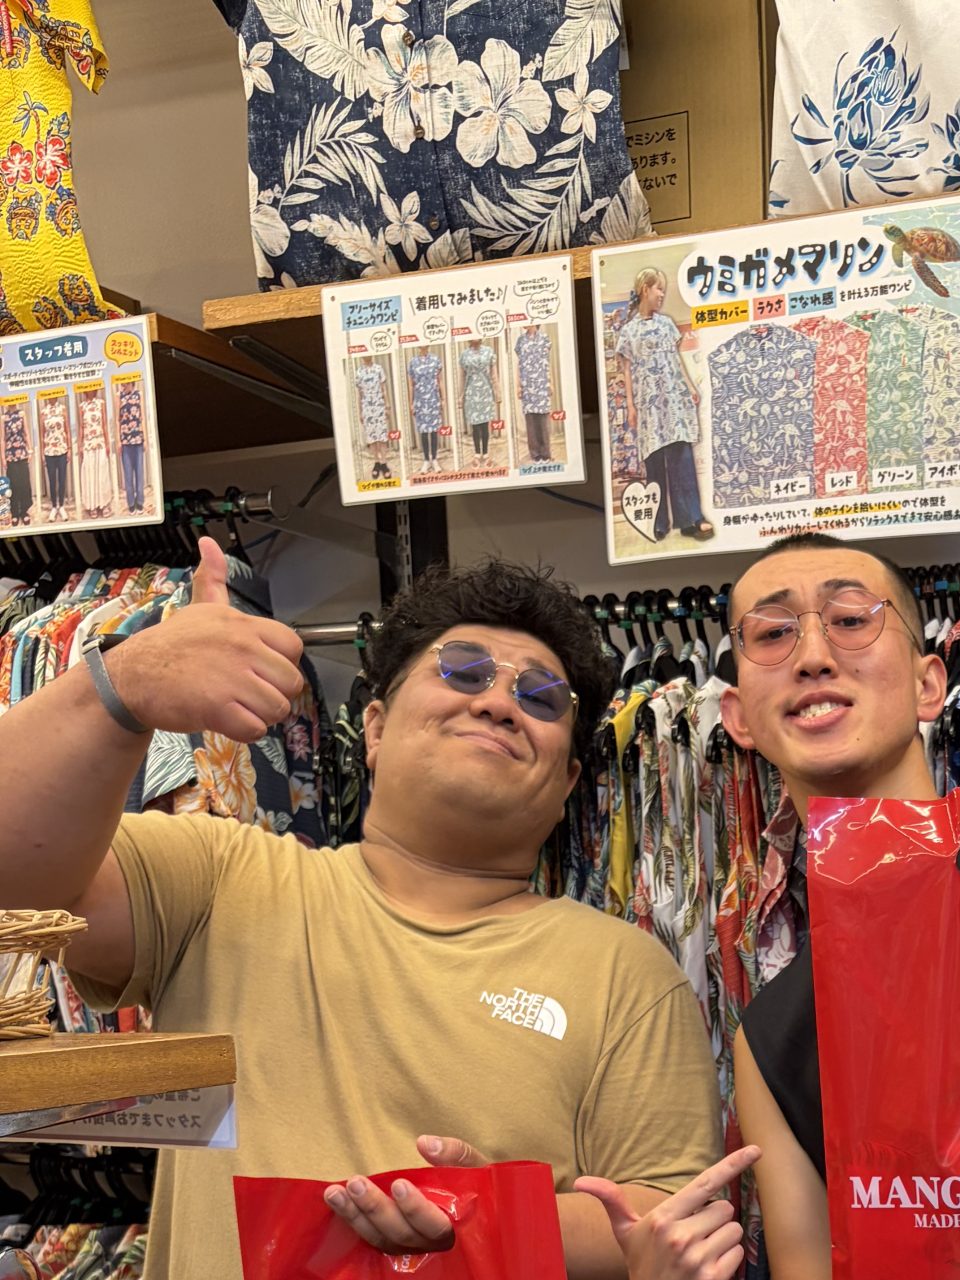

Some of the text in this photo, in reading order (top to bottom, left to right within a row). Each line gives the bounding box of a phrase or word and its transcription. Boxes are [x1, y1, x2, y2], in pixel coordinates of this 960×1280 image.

[686, 236, 885, 299] ウミガメマリン
[348, 299, 393, 315] フリーサイズ
[415, 287, 497, 312] 着用してみました
[694, 278, 913, 324] 体型カバー ラクさ こなれ感 を叶える万能ワンピ
[345, 309, 400, 328] チュニックワンピ
[24, 340, 84, 361] スタッフ着用
[830, 475, 855, 489] レッド
[877, 469, 914, 484] グリーン
[773, 482, 806, 495] ネイビー
[625, 492, 658, 507] スタッフも
[634, 507, 653, 521] 愛用
[479, 990, 543, 1019] NORTH
[512, 986, 546, 1006] THE
[491, 1005, 536, 1030] FACE
